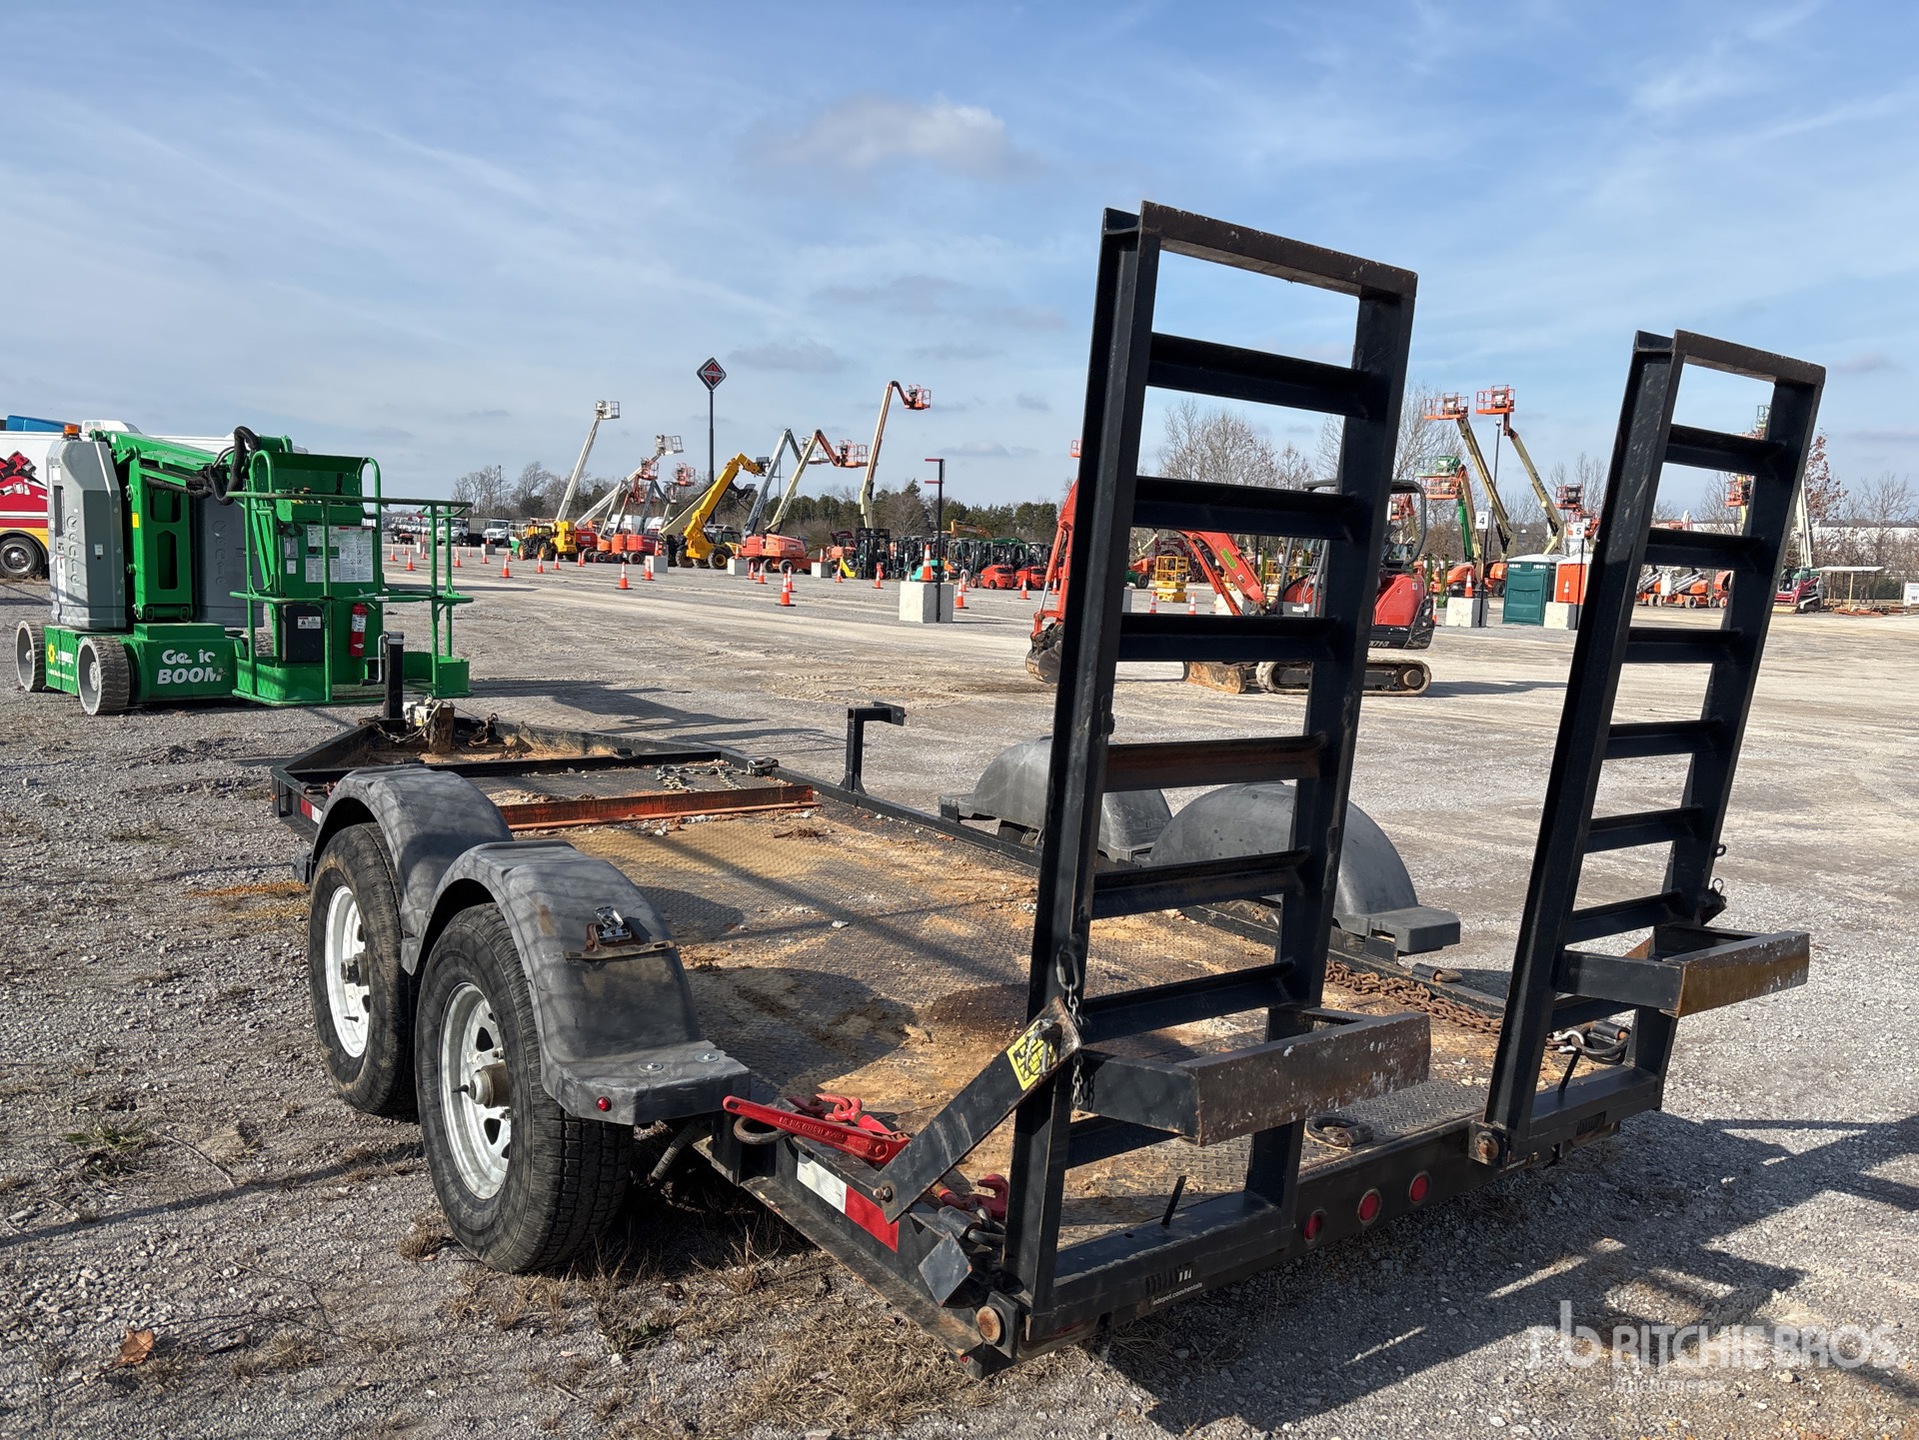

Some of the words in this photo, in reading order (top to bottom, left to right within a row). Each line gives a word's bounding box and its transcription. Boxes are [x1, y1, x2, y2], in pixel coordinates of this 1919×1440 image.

[1479, 517, 1485, 525] 4
[1576, 527, 1582, 535] 5
[157, 666, 223, 685] BOOM
